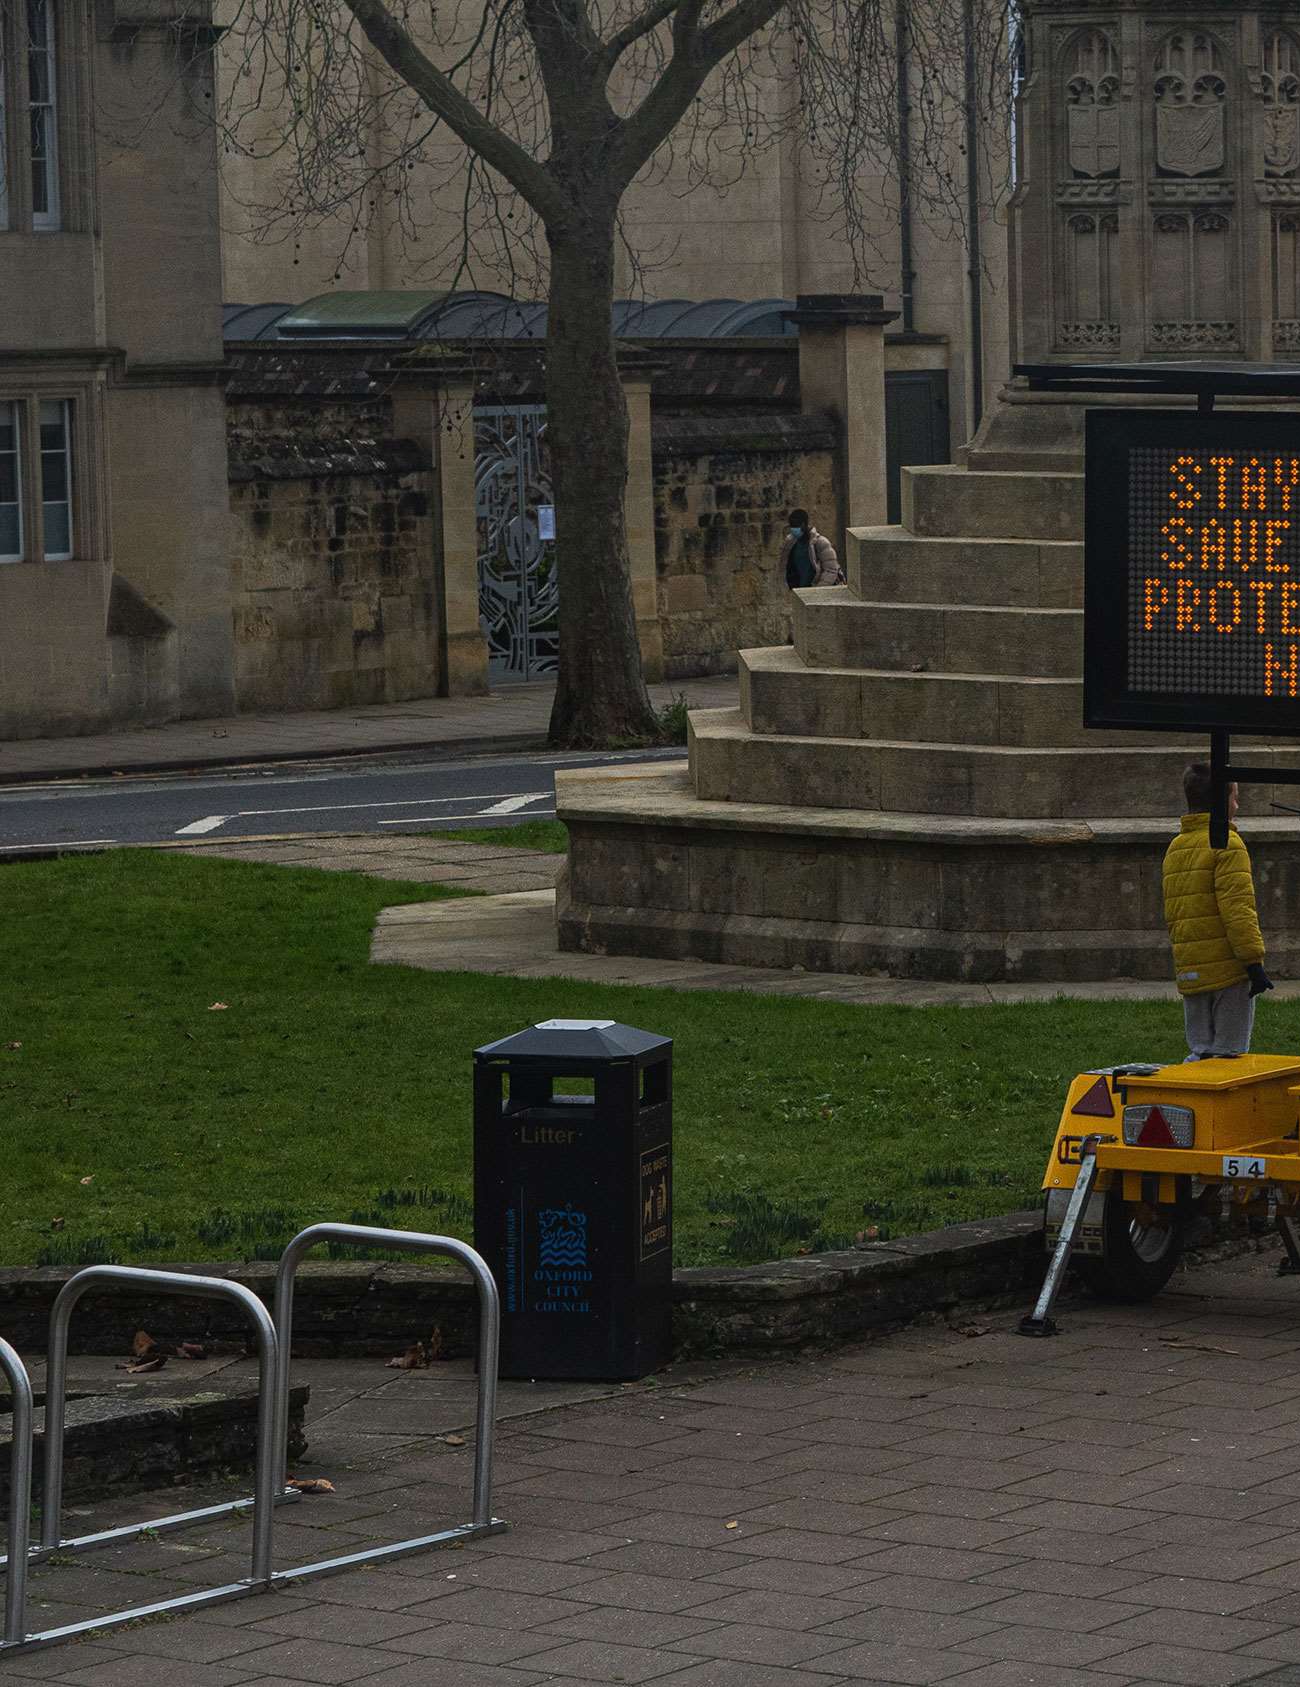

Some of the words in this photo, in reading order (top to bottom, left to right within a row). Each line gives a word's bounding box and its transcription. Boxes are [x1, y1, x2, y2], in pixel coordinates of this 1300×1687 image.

[1169, 456, 1299, 511] STAY
[1160, 517, 1291, 573] SAVE
[520, 1125, 577, 1145] Litter
[531, 1270, 593, 1281] OXFORD
[546, 1286, 582, 1297] CITY
[535, 1301, 592, 1312] COUNCIL
